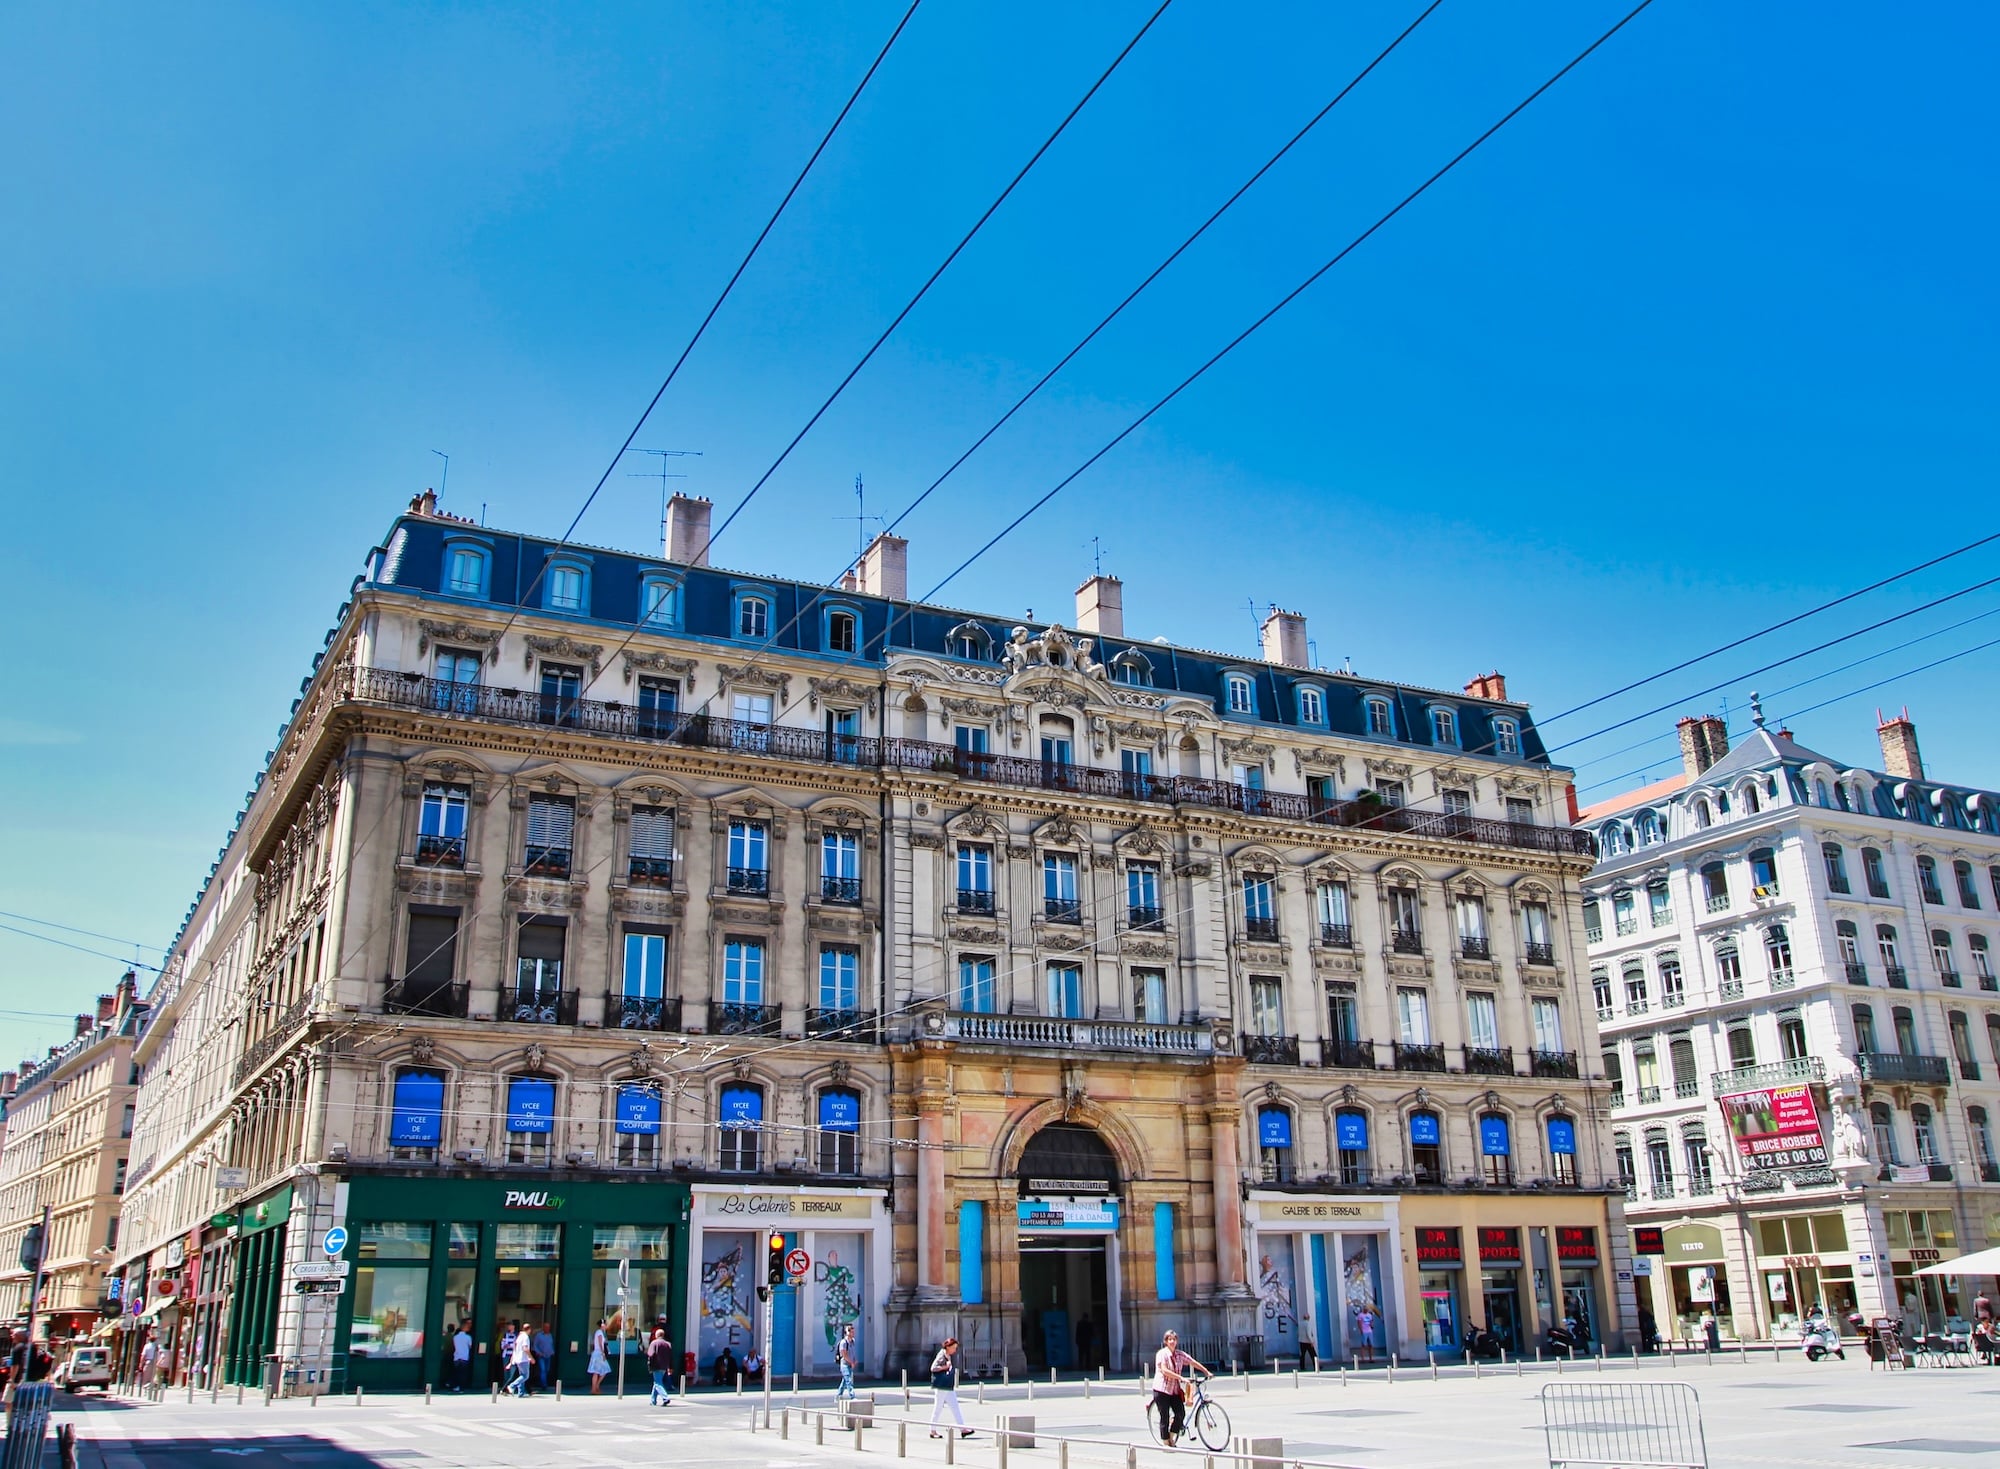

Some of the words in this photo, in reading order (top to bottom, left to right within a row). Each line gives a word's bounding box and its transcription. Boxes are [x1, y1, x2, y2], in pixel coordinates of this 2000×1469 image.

[522, 1102, 540, 1110] LYCEE
[1786, 1108, 1808, 1118] prestige
[412, 1125, 421, 1133] DE
[514, 1120, 545, 1128] COIFFURE
[1753, 1138, 1780, 1152] BRICE
[1781, 1134, 1817, 1148] ROBERT
[1742, 1156, 1757, 1169] 04
[1759, 1154, 1774, 1167] 72
[1775, 1152, 1789, 1164] 83
[1792, 1150, 1807, 1163] 08
[1809, 1148, 1825, 1161] 08
[505, 1191, 549, 1206] PMU
[546, 1196, 565, 1209] city
[718, 1195, 745, 1212] La
[748, 1195, 789, 1214] Galerie
[802, 1201, 842, 1212] TERREAUX
[1282, 1206, 1310, 1215] GALERIE
[1314, 1207, 1327, 1215] DES
[1331, 1207, 1361, 1216] TERREAUX
[1087, 1213, 1112, 1221] DANSE
[1426, 1231, 1447, 1242] DM
[1487, 1230, 1505, 1241] DM
[1564, 1229, 1583, 1241] DM
[1557, 1246, 1596, 1257] SPORTS
[1681, 1242, 1704, 1250] TEXTO
[1417, 1248, 1460, 1258] SPORTS
[1479, 1247, 1520, 1258] SPORTS
[1909, 1249, 1940, 1260] TEXTO
[300, 1264, 343, 1273] CROIX-ROUSSE
